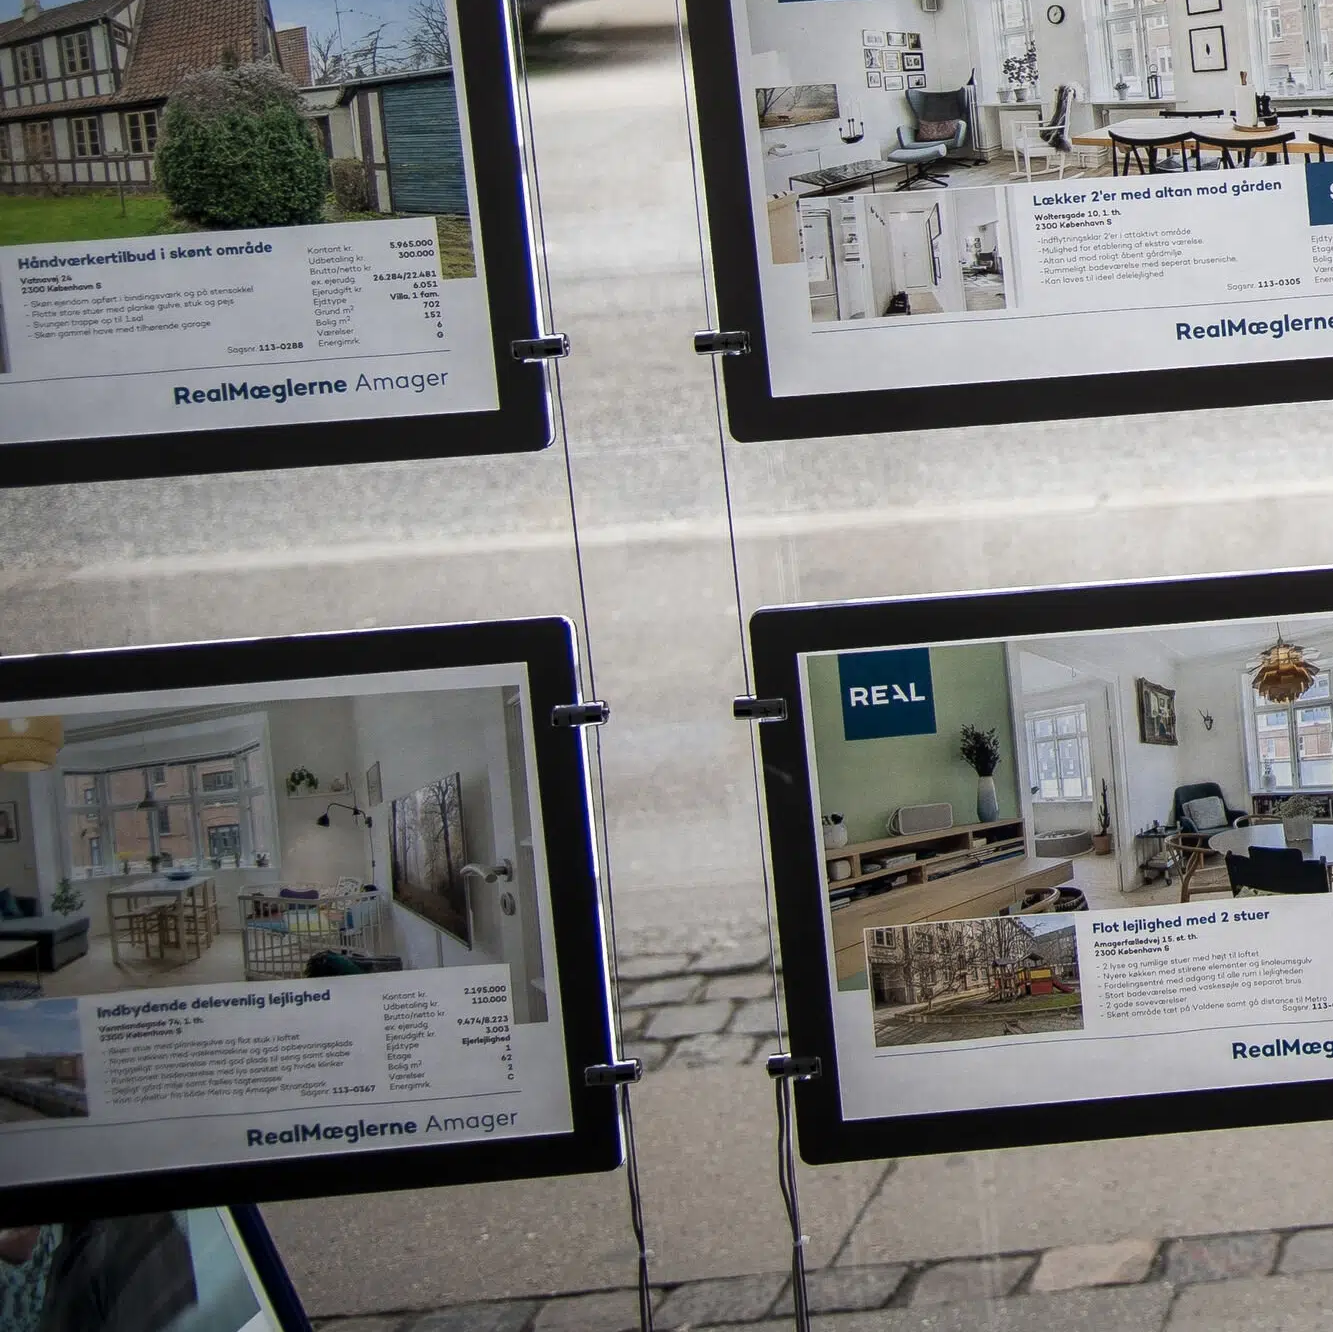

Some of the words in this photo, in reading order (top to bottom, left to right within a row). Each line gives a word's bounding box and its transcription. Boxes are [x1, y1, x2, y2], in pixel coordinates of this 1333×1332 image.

[1032, 192, 1086, 206] Lækker
[1090, 189, 1117, 202] 2'er
[1120, 187, 1151, 200] med
[1154, 186, 1192, 198] altan
[1196, 181, 1227, 195] mod
[1231, 179, 1281, 196] gården
[1033, 210, 1086, 221] Woltersgade
[17, 248, 156, 270] Håndværkertilbud
[159, 247, 165, 260] i
[169, 245, 212, 259] skønt
[215, 240, 272, 256] område
[1257, 277, 1301, 288] 113-0305
[258, 341, 304, 352] 113-0288
[173, 377, 347, 405] RealMæglerne
[355, 372, 448, 393] Amager
[849, 682, 926, 707] REAL
[1092, 921, 1119, 934] Flot
[1122, 915, 1182, 934] lejlighed
[1185, 911, 1216, 926] med
[1220, 911, 1229, 922] 2
[1233, 910, 1270, 922] stuer
[96, 998, 187, 1019] Indbydende
[190, 993, 265, 1009] delevenlig
[268, 988, 330, 1007] lejlighed
[246, 1119, 417, 1147] RealMæglerne
[425, 1112, 517, 1133] Amager
